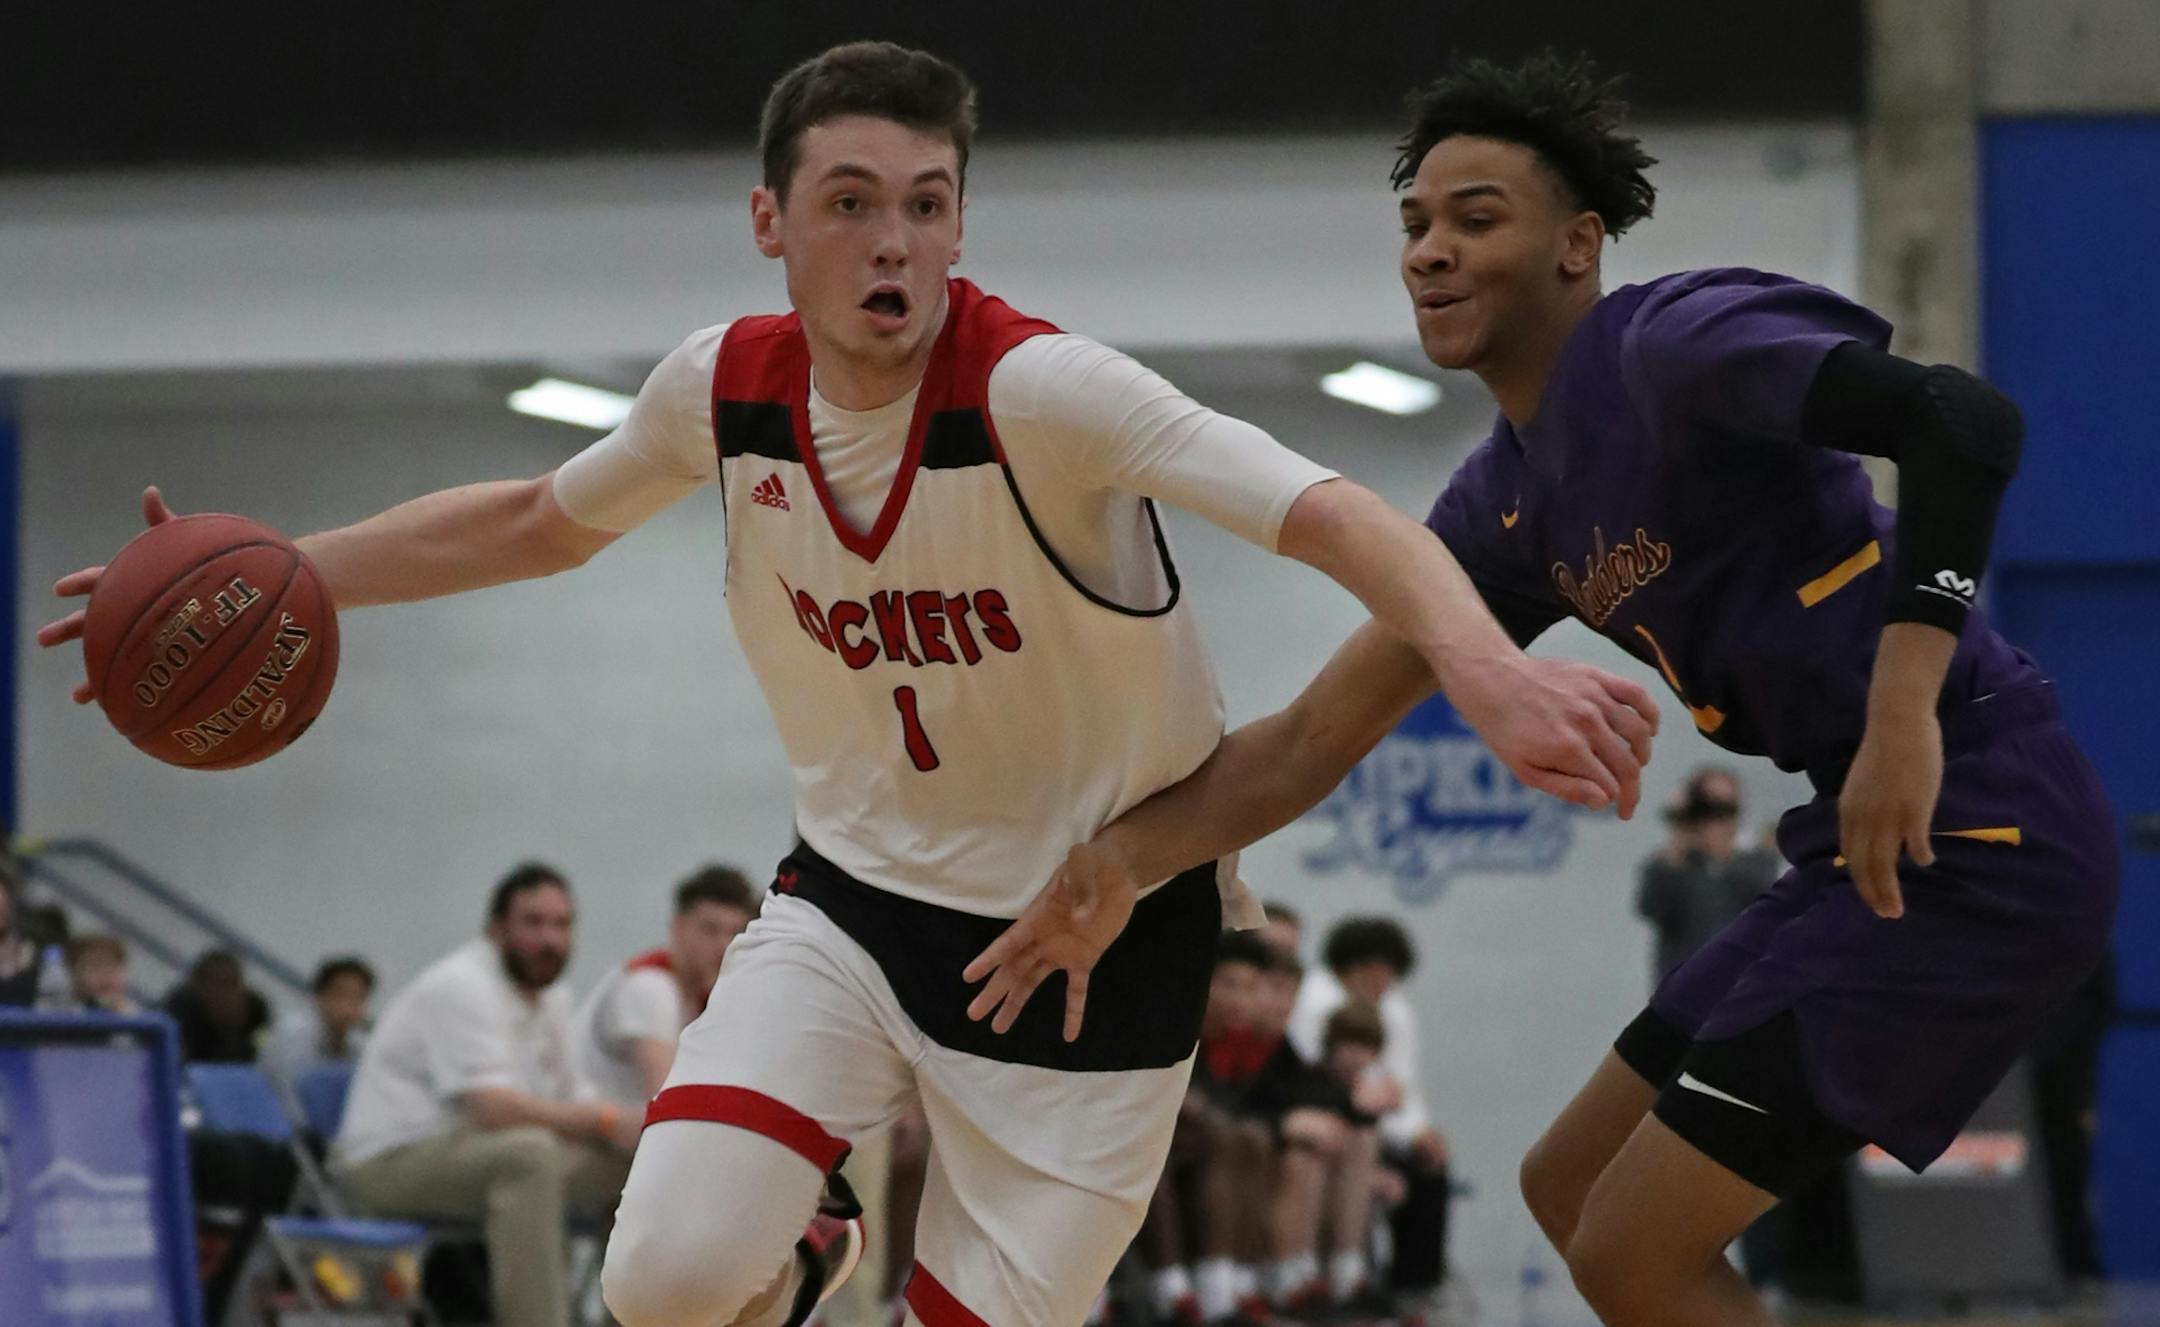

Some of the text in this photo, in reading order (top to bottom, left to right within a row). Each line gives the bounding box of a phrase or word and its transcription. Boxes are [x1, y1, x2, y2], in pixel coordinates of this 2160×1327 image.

[751, 492, 790, 512] adidas
[776, 572, 1022, 670] OCKETS
[171, 611, 311, 756] SPALDING
[893, 685, 940, 772] 1
